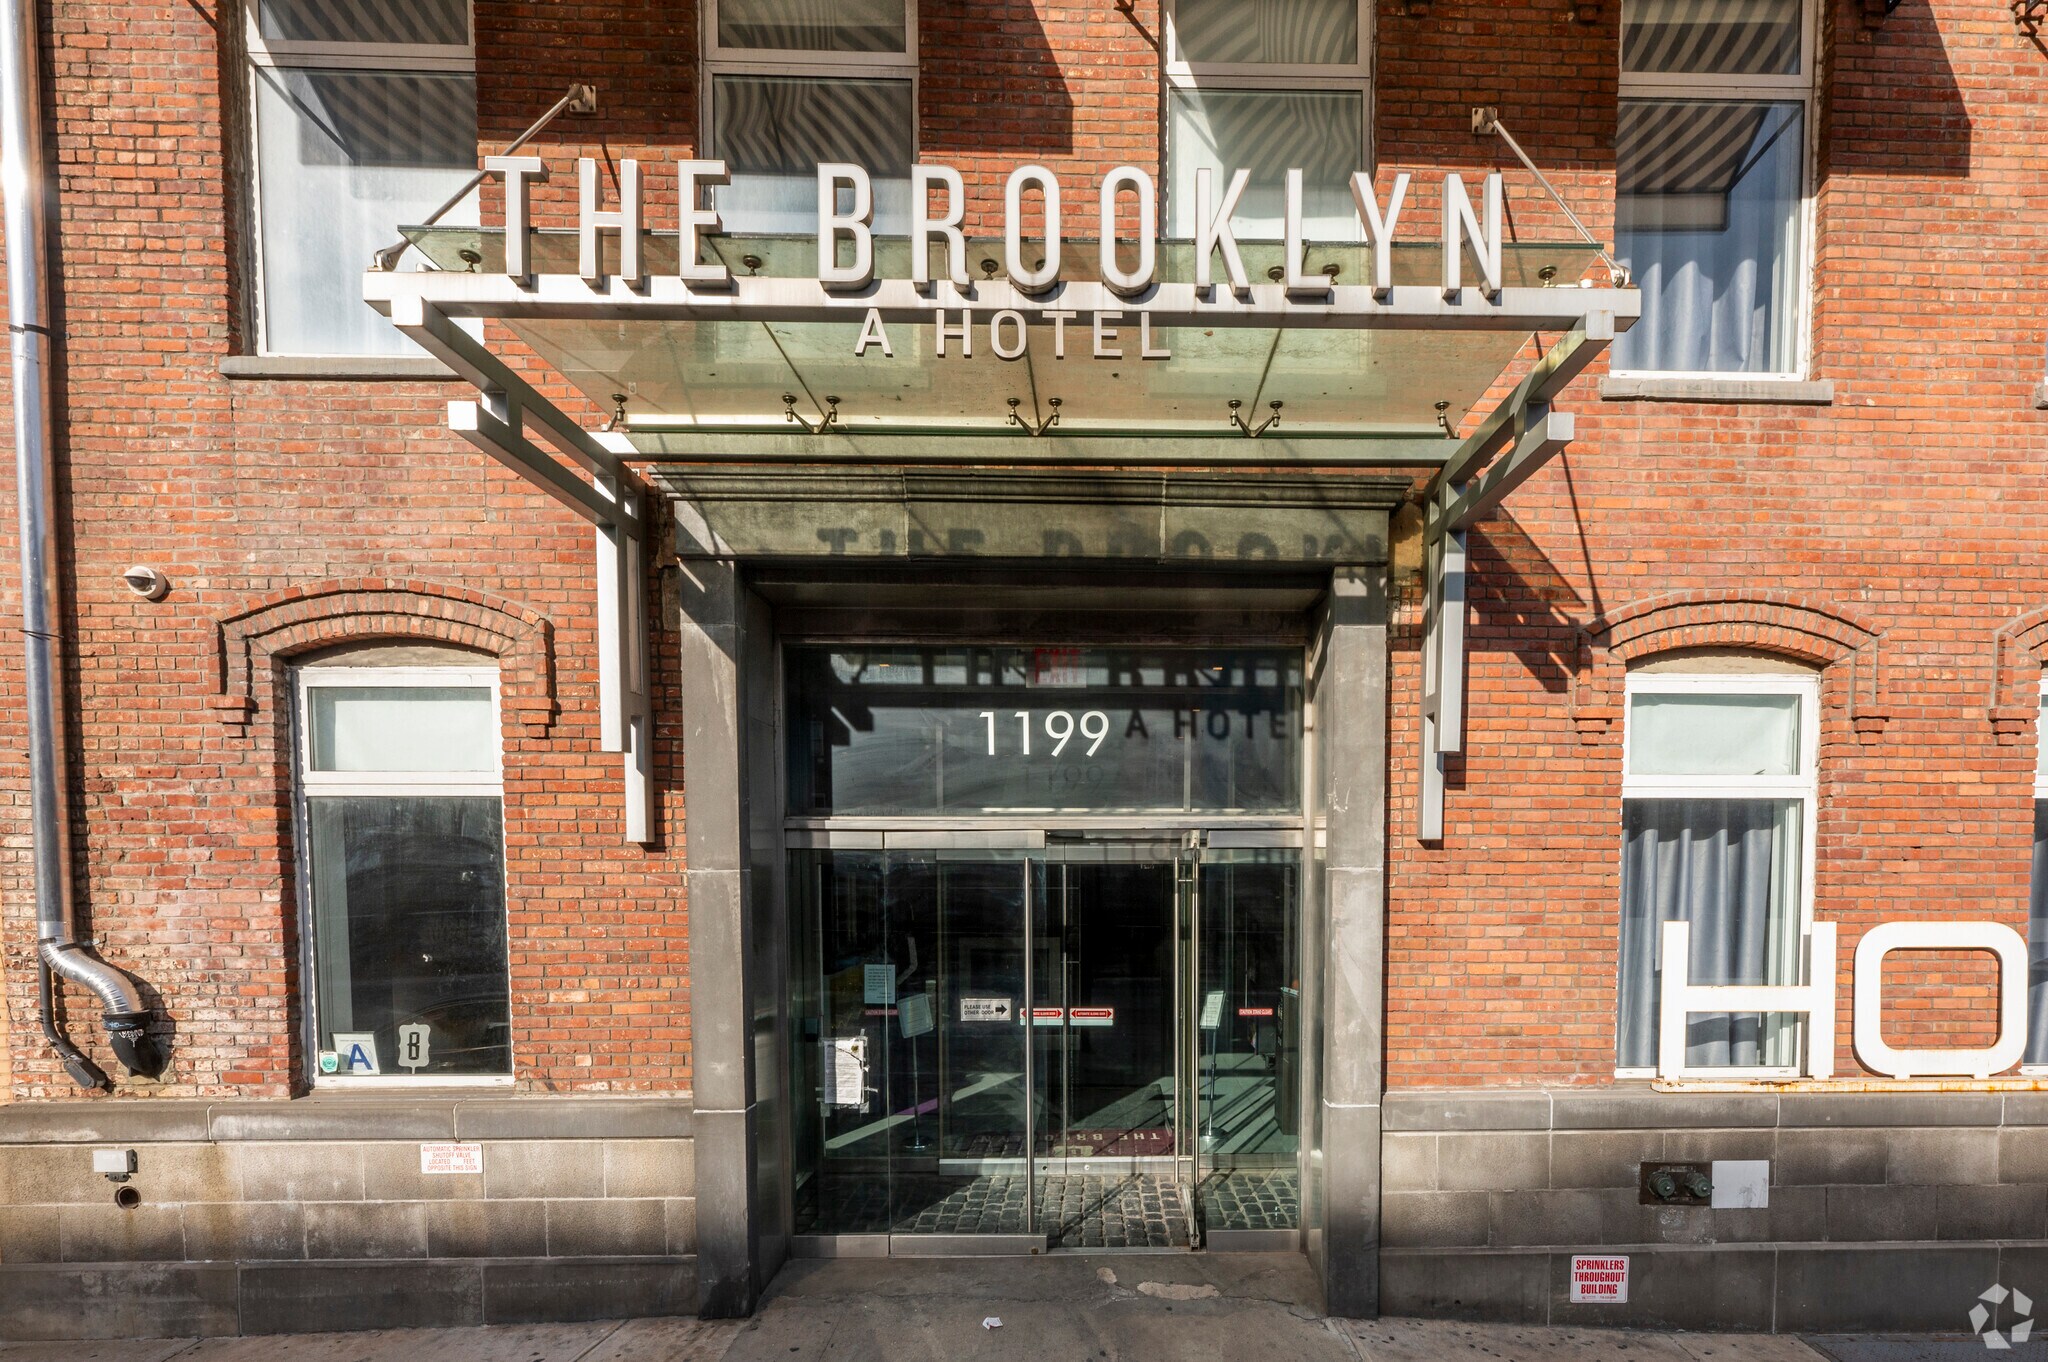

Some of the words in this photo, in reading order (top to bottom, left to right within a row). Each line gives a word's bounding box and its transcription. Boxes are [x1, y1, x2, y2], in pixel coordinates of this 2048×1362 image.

[484, 156, 731, 290] THE
[817, 161, 1502, 300] BROOKLYN
[854, 309, 893, 358] A
[936, 309, 1171, 360] HOTEL
[1034, 648, 1081, 683] EXIT
[979, 710, 1110, 758] 1199
[1659, 920, 2029, 1078] HO
[347, 1043, 373, 1070] A
[1574, 1271, 1626, 1282] THROUGHOUT
[1576, 1259, 1625, 1270] SPRINKLERS
[1581, 1284, 1618, 1294] BUILDING
